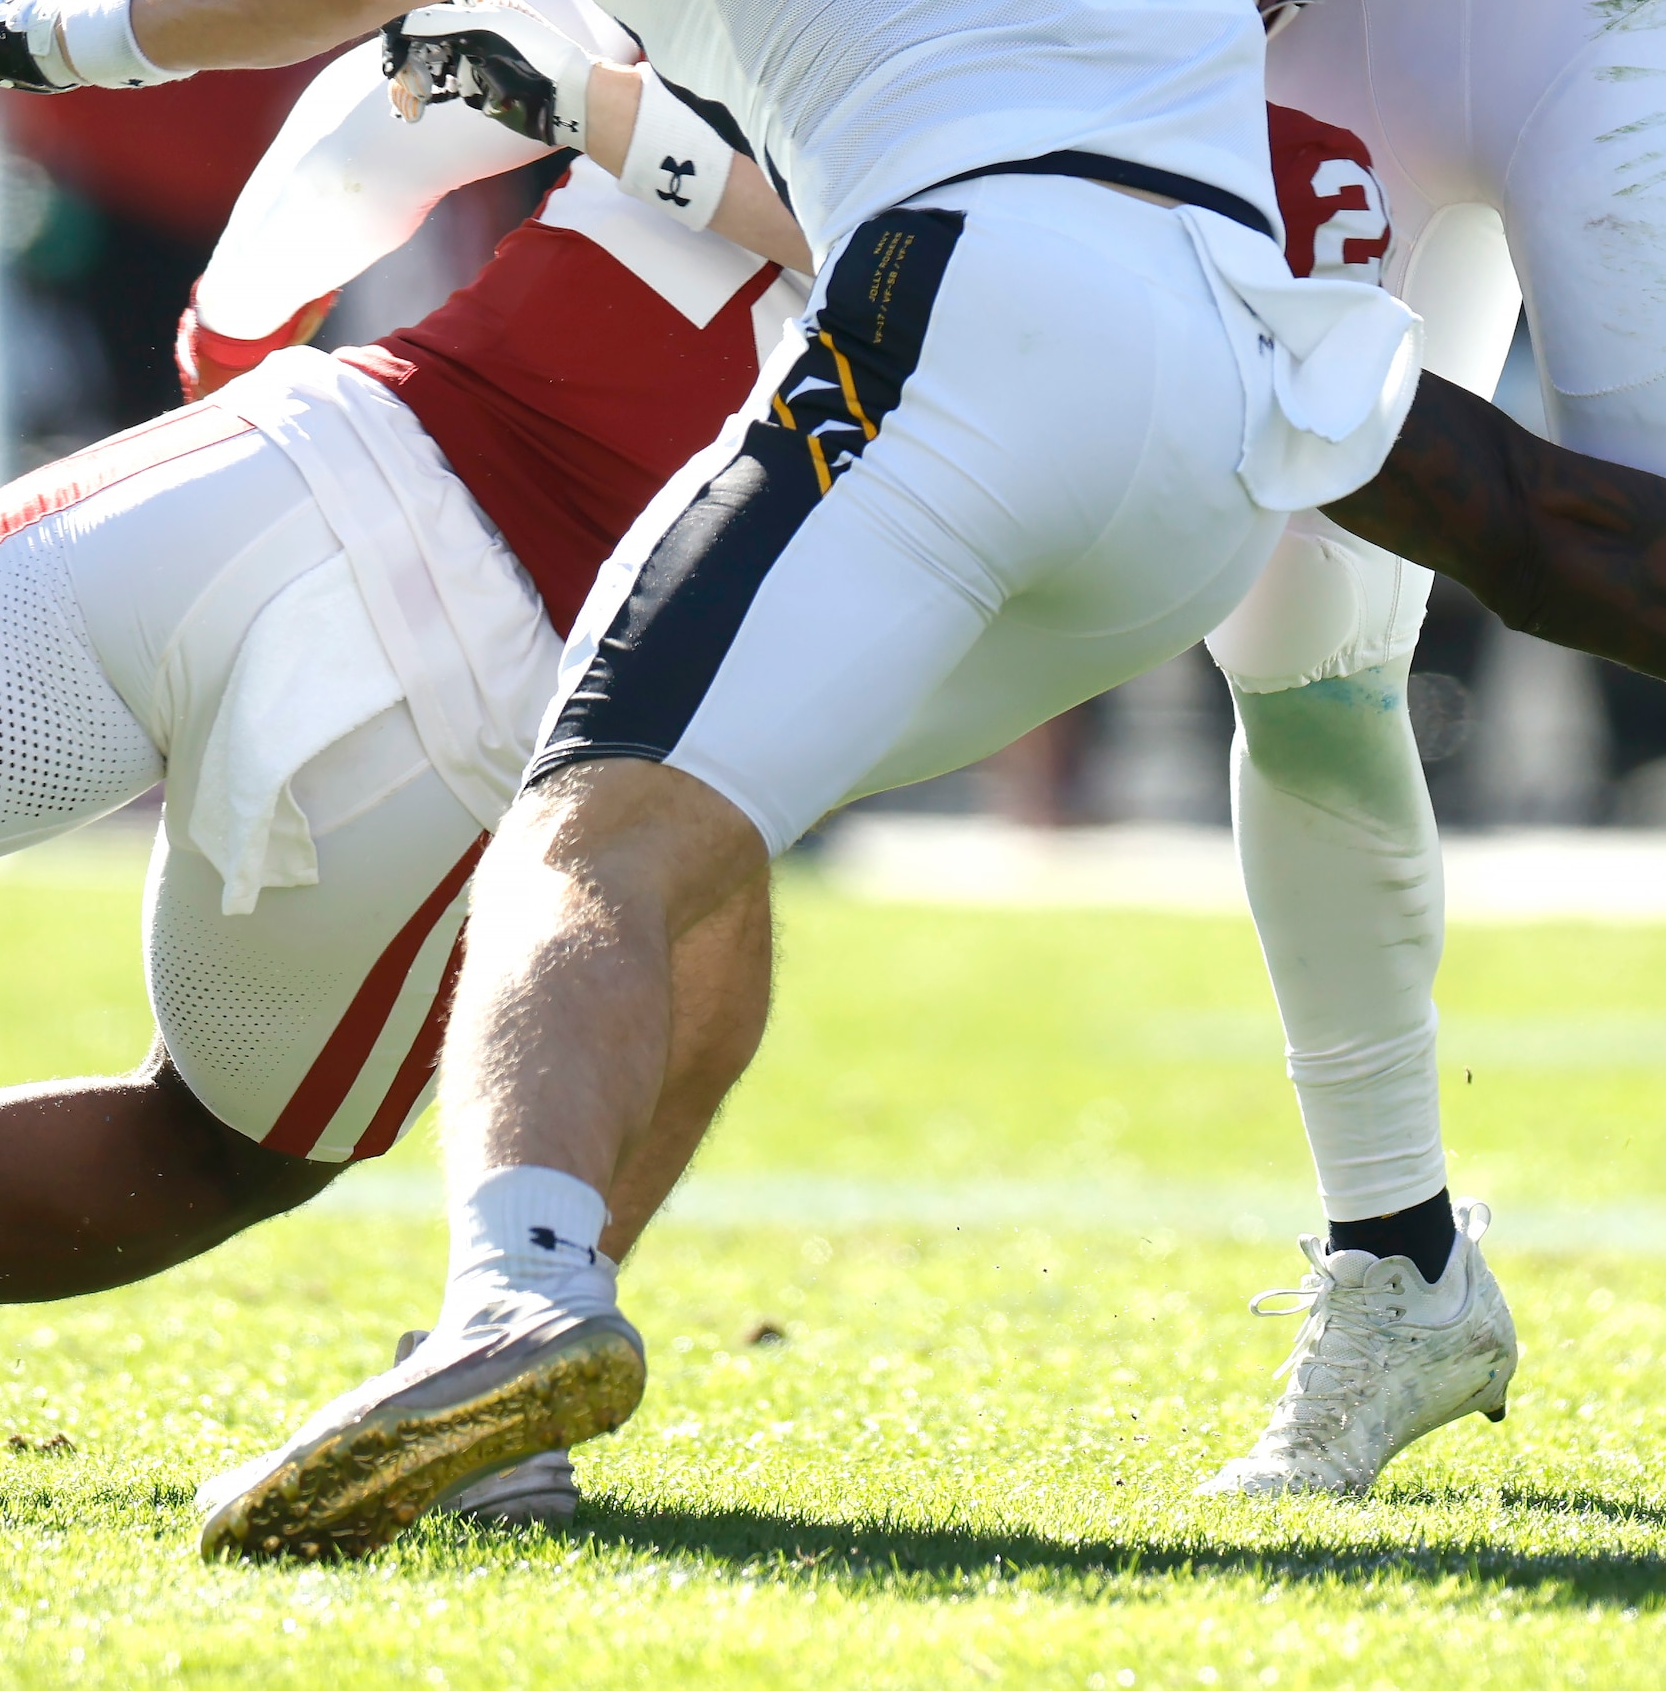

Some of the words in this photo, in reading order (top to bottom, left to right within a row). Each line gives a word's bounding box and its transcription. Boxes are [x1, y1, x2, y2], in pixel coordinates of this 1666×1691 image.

[873, 231, 890, 255] NAVY
[1309, 158, 1389, 287] 2
[869, 270, 882, 302] JOLLY
[881, 232, 903, 269] ROGERS
